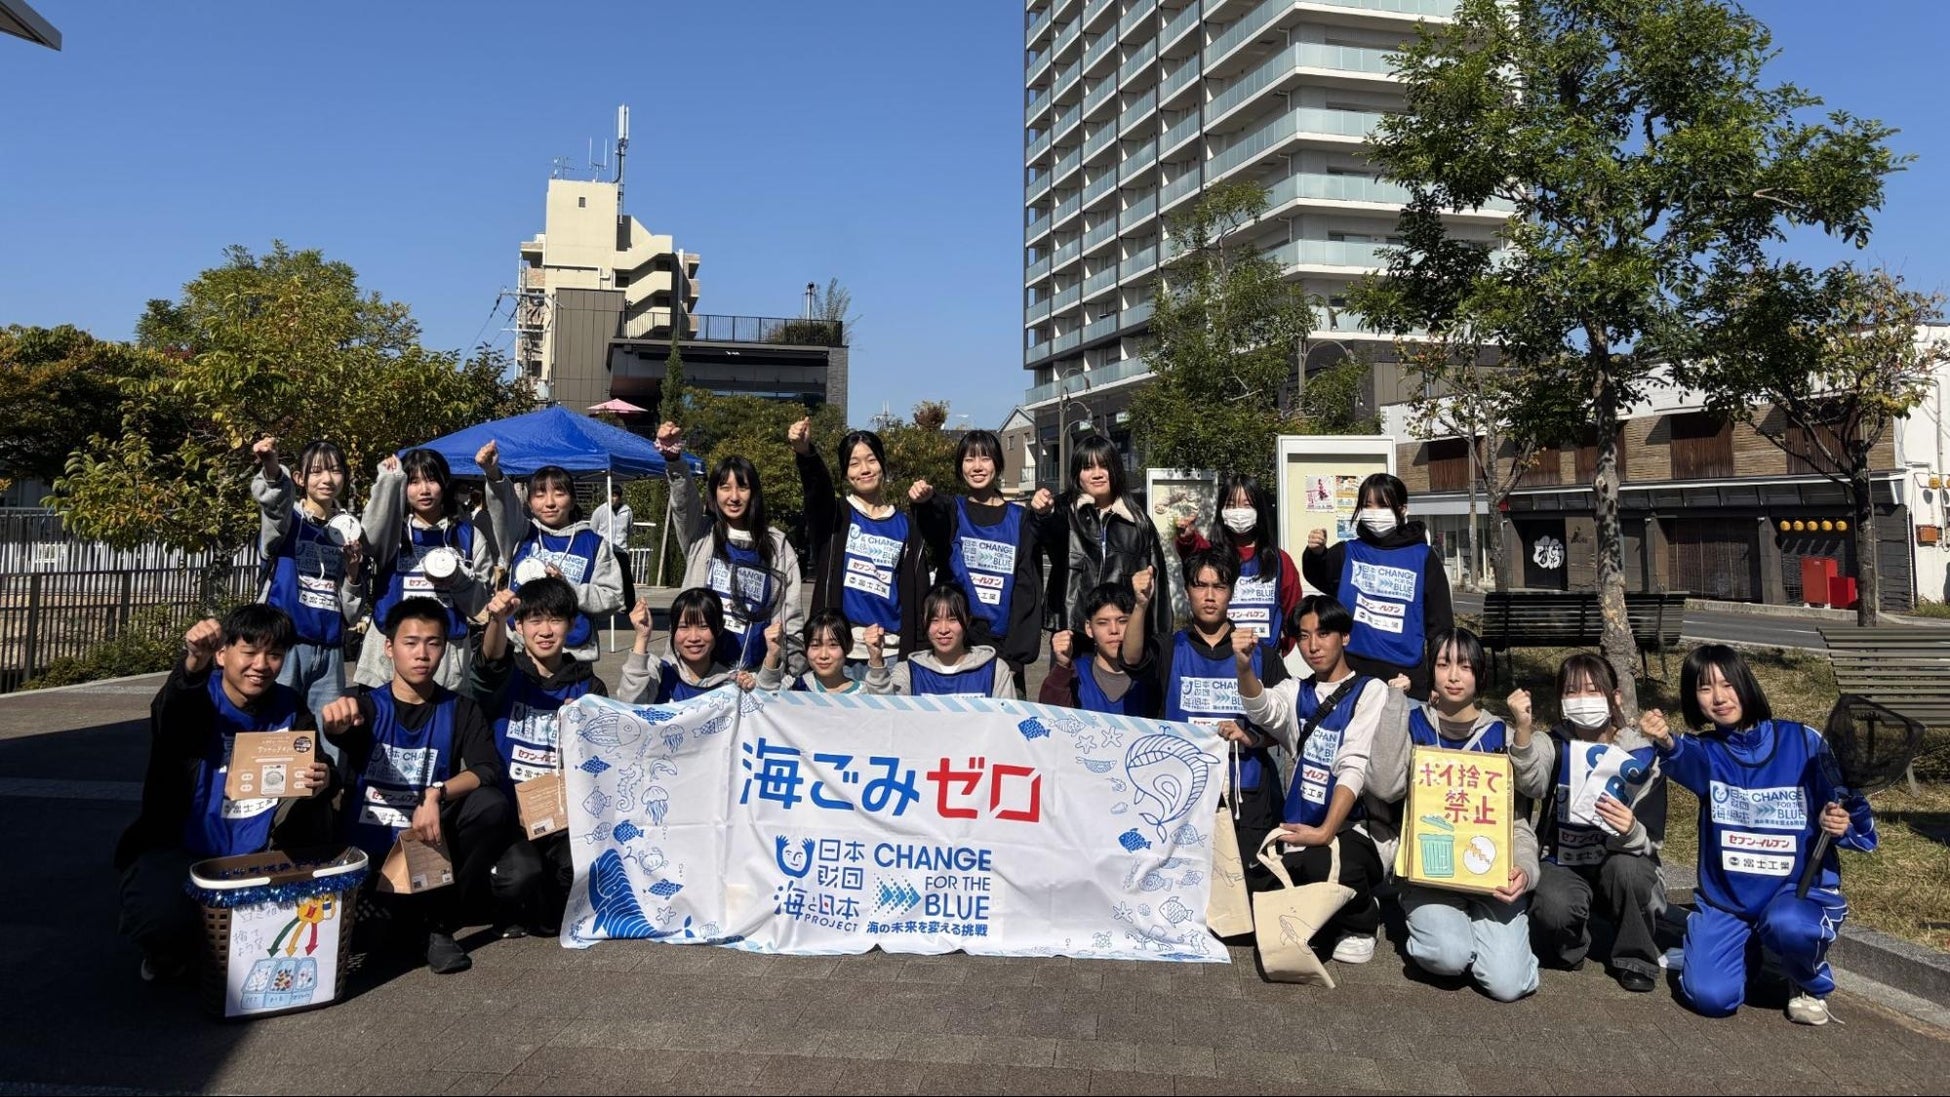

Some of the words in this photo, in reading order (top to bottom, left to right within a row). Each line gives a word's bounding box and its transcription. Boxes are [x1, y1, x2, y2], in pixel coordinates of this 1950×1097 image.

[979, 542, 1013, 554] CHANGE
[993, 557, 1013, 567] BLUE
[1378, 567, 1414, 579] CHANGE
[1256, 590, 1275, 598] BLUE
[1212, 681, 1238, 689] CHAN
[740, 738, 1042, 823] 海ごみゼロ
[1752, 790, 1802, 802] CHANGE
[1444, 789, 1497, 824] 禁止
[1778, 808, 1804, 819] BLUE
[819, 838, 865, 862] 日本
[874, 843, 991, 871] CHANGE
[818, 865, 863, 890] 財団
[925, 876, 957, 891] FOR
[962, 876, 991, 891] THE
[774, 880, 859, 920] 海と日本
[925, 893, 990, 920] BLUE
[804, 914, 858, 932] PROJECT
[867, 921, 988, 936] 海の未来を変える挑戦
